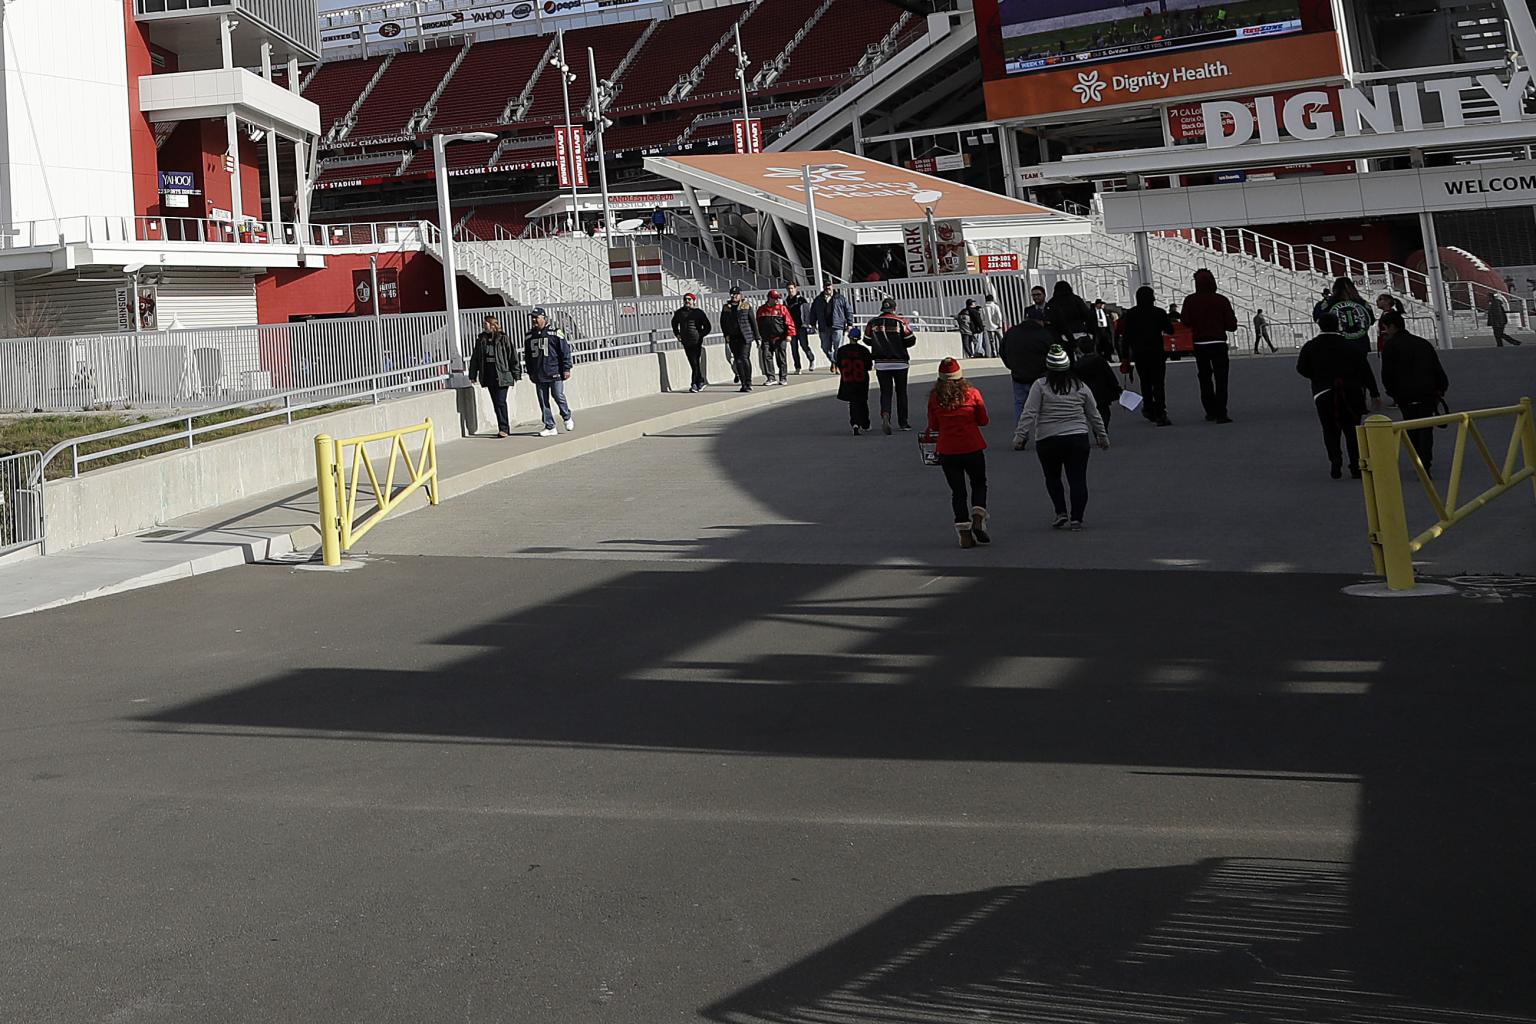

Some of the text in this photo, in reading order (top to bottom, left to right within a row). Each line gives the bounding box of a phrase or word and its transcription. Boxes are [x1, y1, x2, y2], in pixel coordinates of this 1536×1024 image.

[471, 9, 506, 23] YAHOO!
[422, 19, 453, 31] BROCADE
[322, 33, 352, 43] UNITED
[1112, 61, 1228, 93] Dignity Health
[1202, 74, 1532, 150] DIGNITY
[330, 142, 357, 151] BOWL
[359, 134, 417, 147] CHAMPIONS
[449, 166, 486, 177] WELCOME
[531, 160, 559, 169] STADIU
[162, 175, 192, 186] YAHOO!
[330, 180, 362, 189] STADIUM
[909, 226, 926, 275] CLARK
[117, 290, 128, 329] JOHNSON
[530, 337, 549, 358] 54
